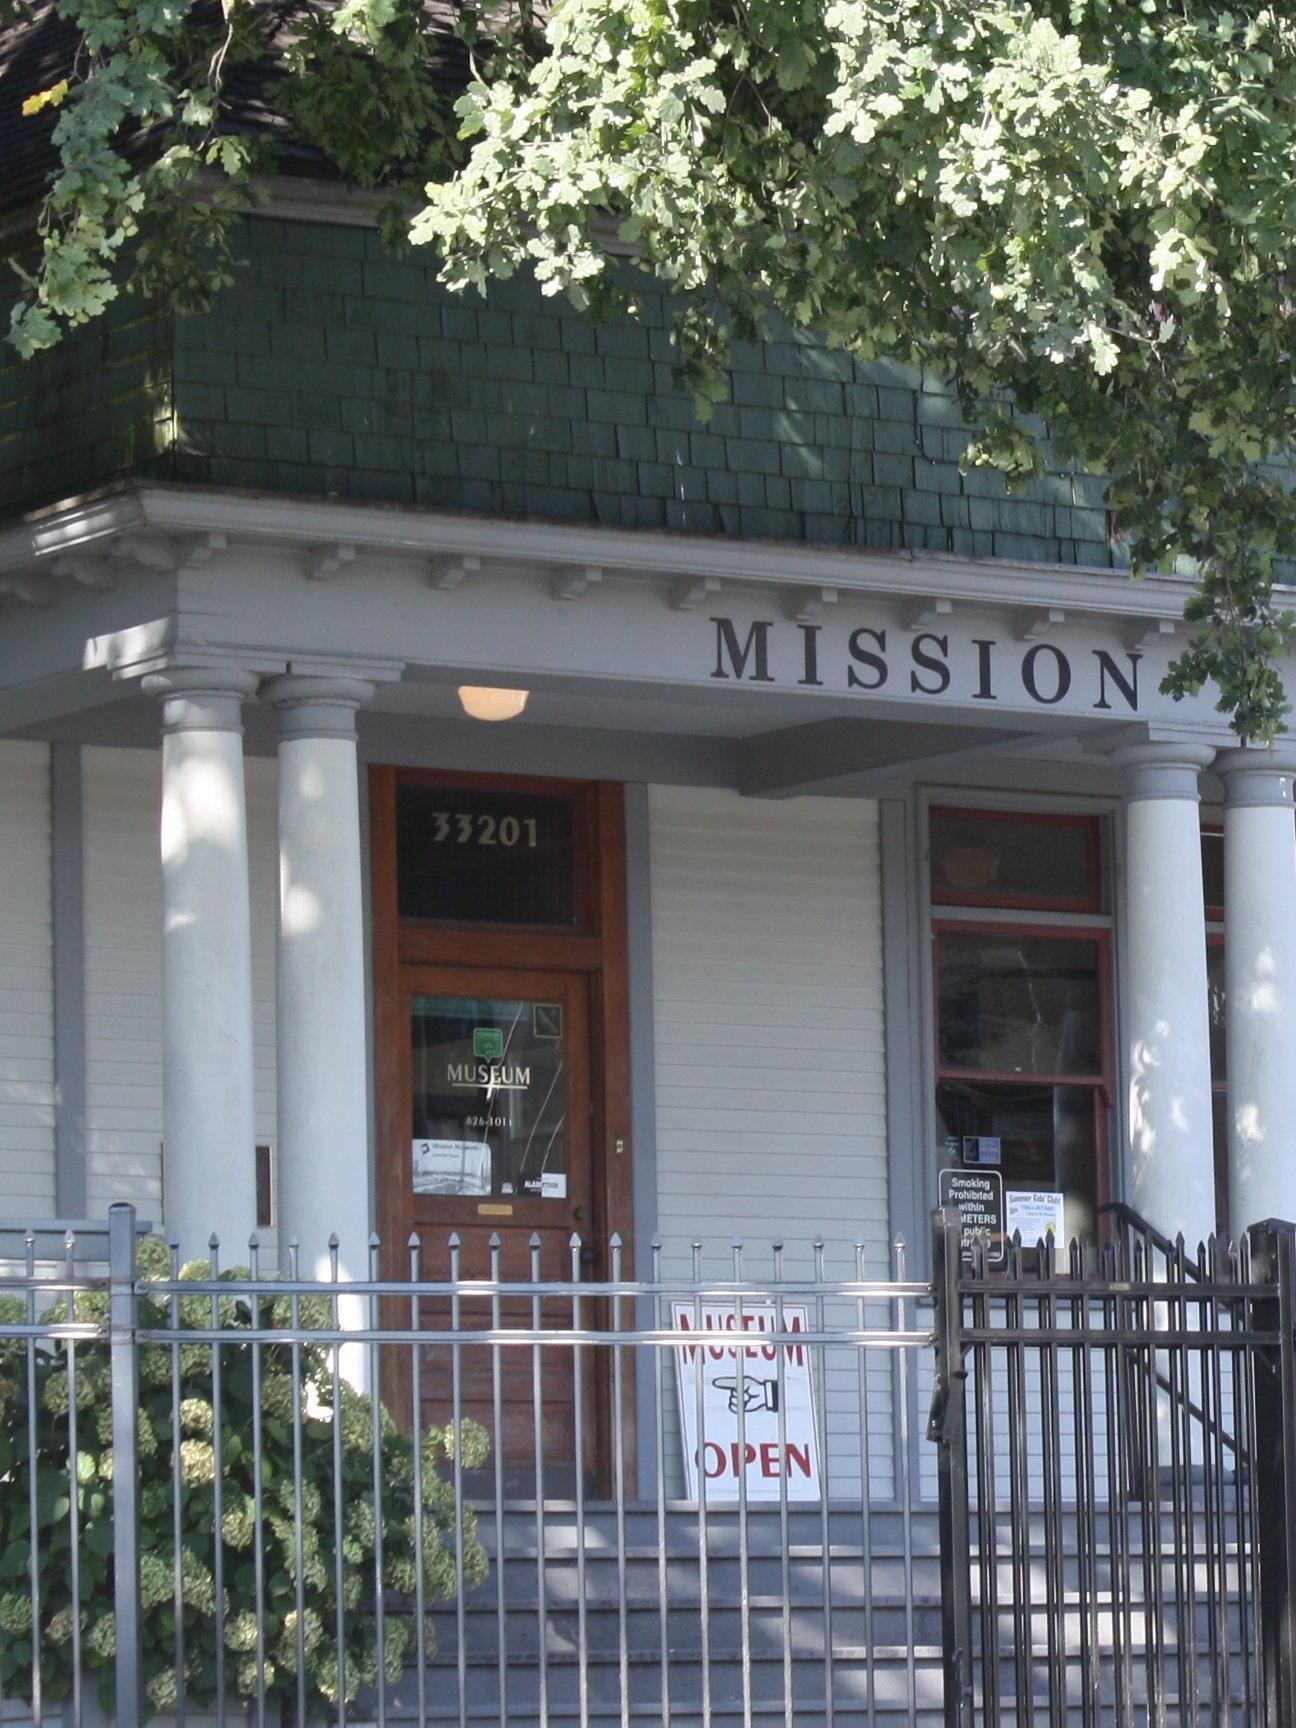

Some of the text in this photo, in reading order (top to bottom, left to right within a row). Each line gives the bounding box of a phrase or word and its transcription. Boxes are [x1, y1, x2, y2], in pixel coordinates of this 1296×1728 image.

[711, 616, 1143, 711] MISSION
[432, 811, 537, 848] 33201
[447, 1063, 531, 1085] MUSEUM
[948, 1189, 994, 1201] Prohibited
[951, 1177, 991, 1191] Smoking
[958, 1201, 985, 1212] within
[679, 1312, 804, 1367] MUSEUM
[694, 1441, 812, 1479] OPEN
